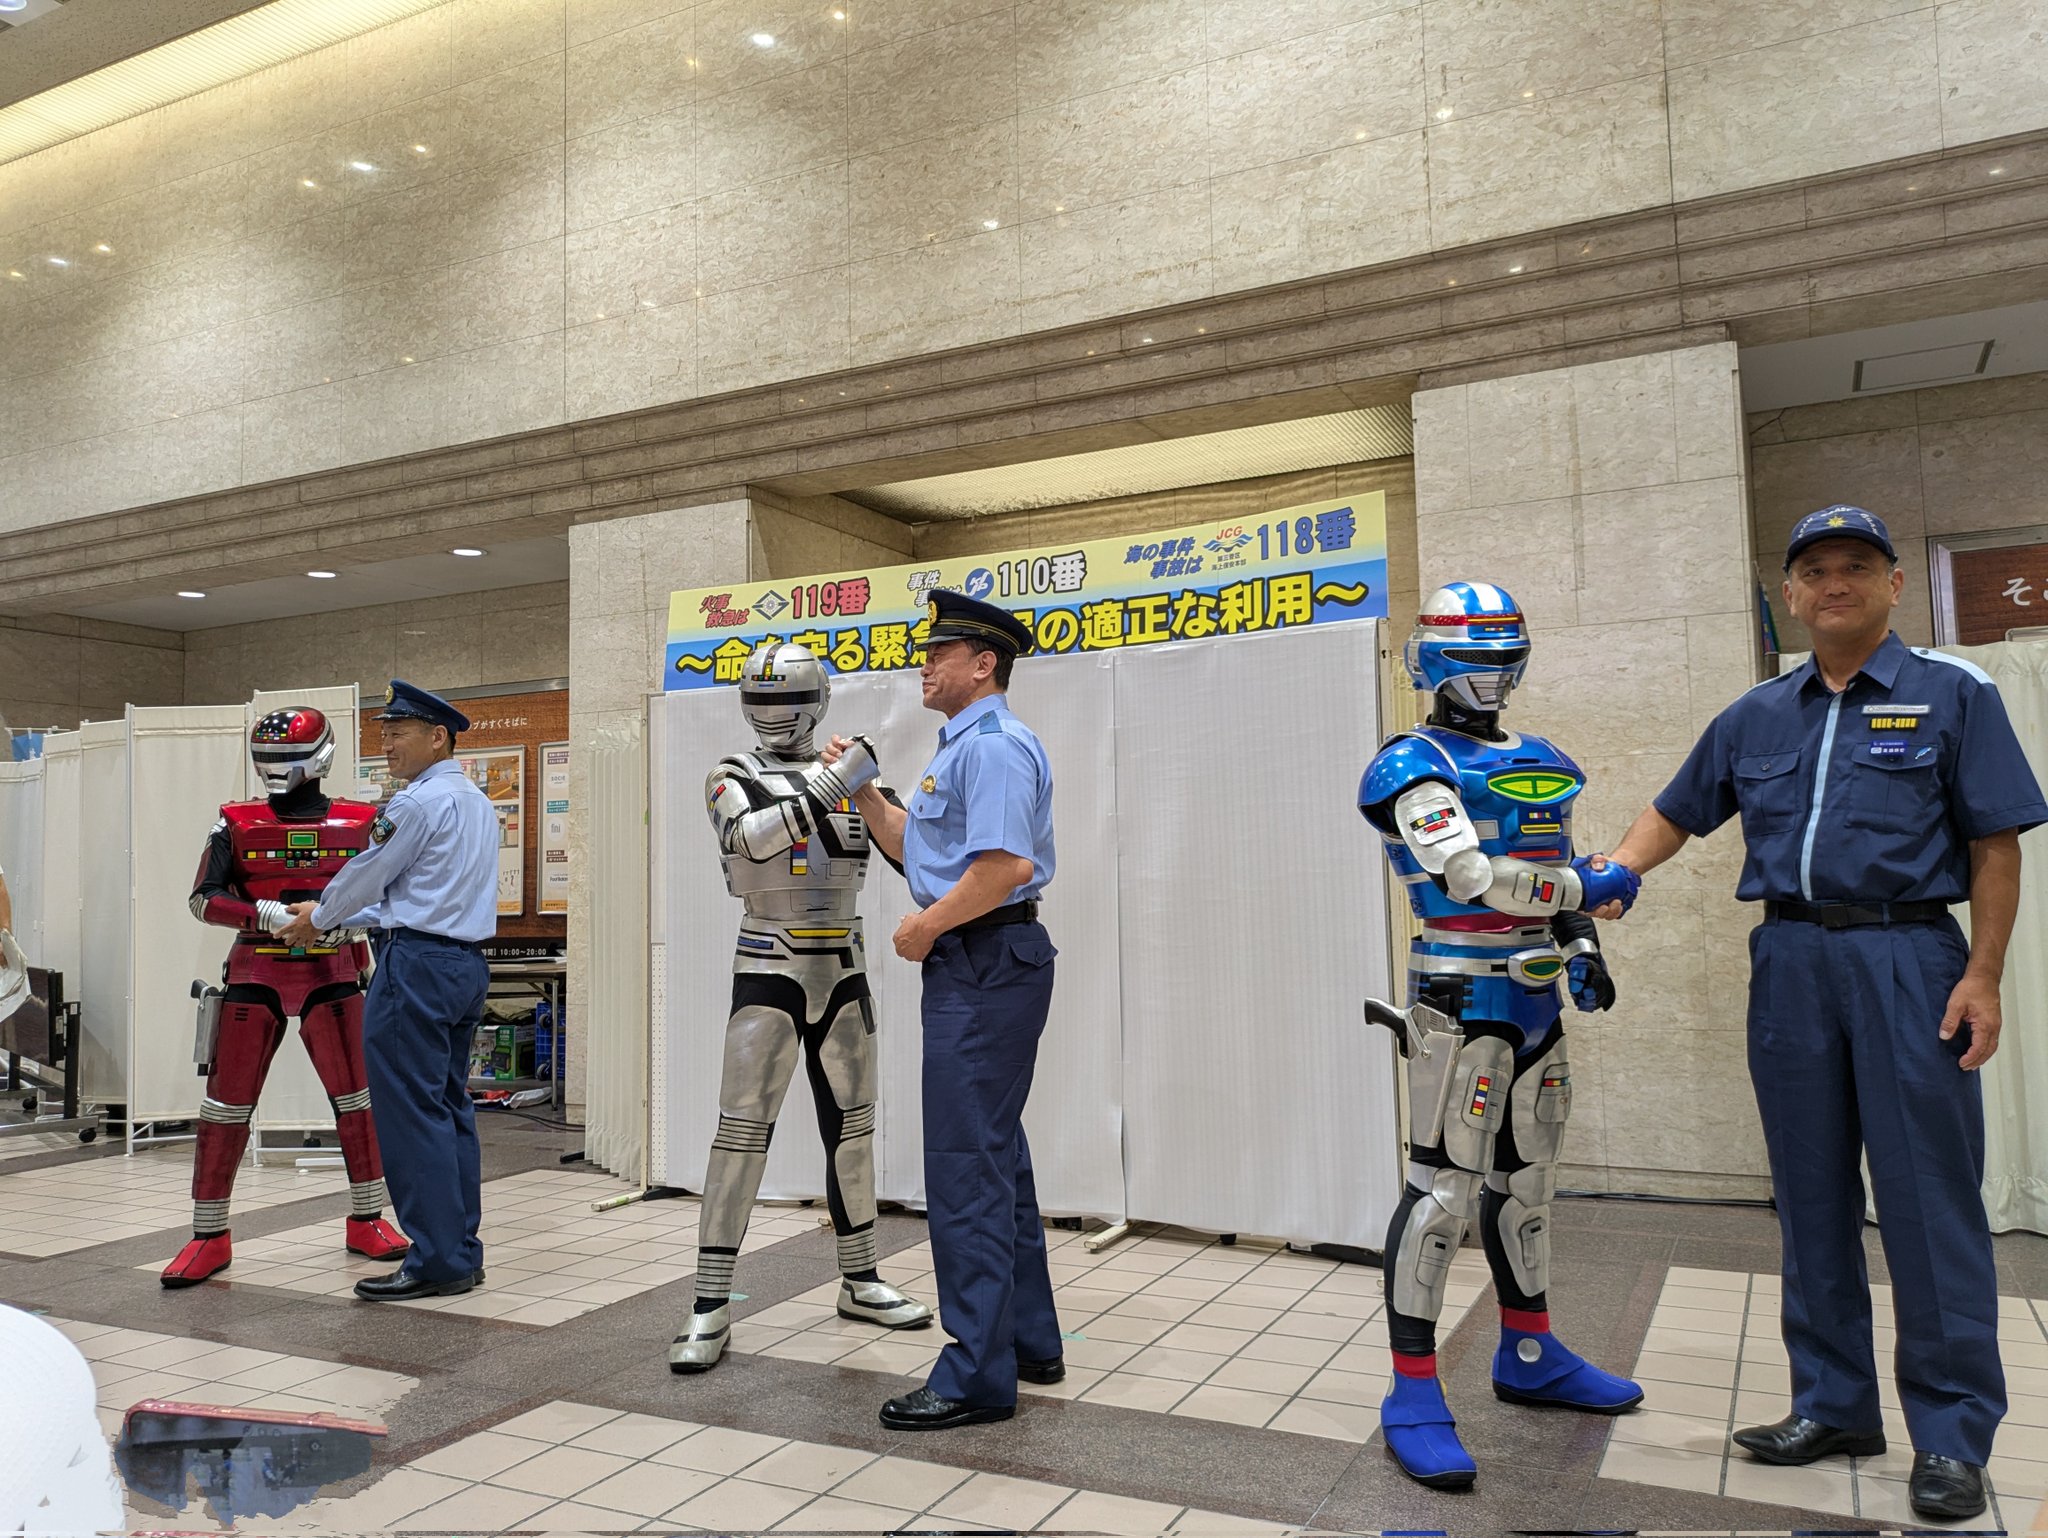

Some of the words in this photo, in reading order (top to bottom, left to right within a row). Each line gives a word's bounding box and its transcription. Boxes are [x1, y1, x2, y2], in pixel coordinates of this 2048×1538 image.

[1216, 526, 1243, 540] JCG
[1257, 507, 1355, 560] 118番
[1123, 536, 1197, 565] 海の事件
[998, 550, 1087, 597] 110番
[1150, 555, 1203, 579] 事故は
[907, 569, 941, 591] 事件
[699, 594, 732, 613] 火事
[790, 576, 870, 620] 119番
[705, 608, 750, 629] 救急は
